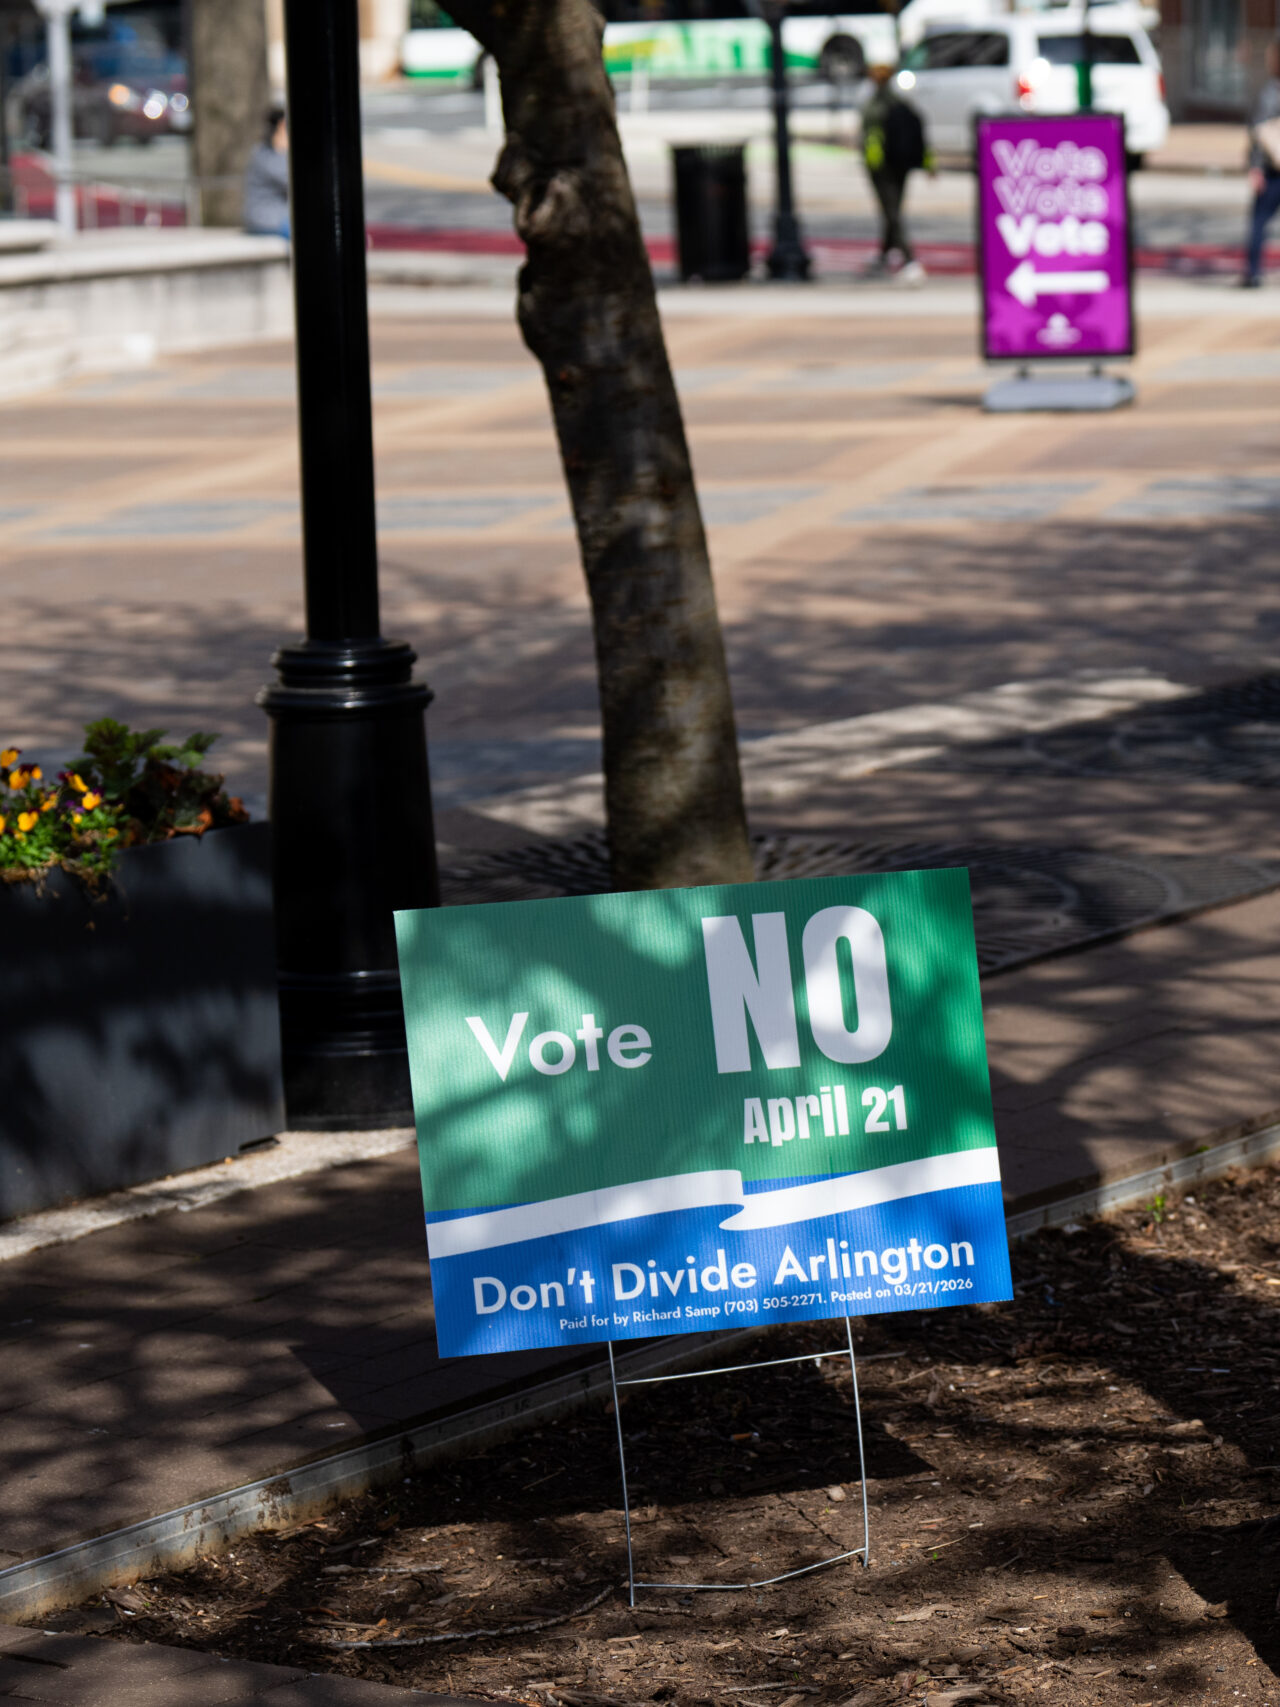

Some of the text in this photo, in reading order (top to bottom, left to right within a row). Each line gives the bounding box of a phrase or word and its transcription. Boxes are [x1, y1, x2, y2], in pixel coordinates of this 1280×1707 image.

[991, 139, 1108, 184] Vote
[992, 176, 1109, 220] Vote
[996, 213, 1109, 258] Vote
[465, 904, 893, 1083] Vote NO
[744, 1085, 908, 1147] April 21
[473, 1237, 975, 1315] Don't Divide Arlington
[559, 1278, 973, 1330] Paid for by Richard Samp (703) 505-2271. Posted on 03/21/2026
